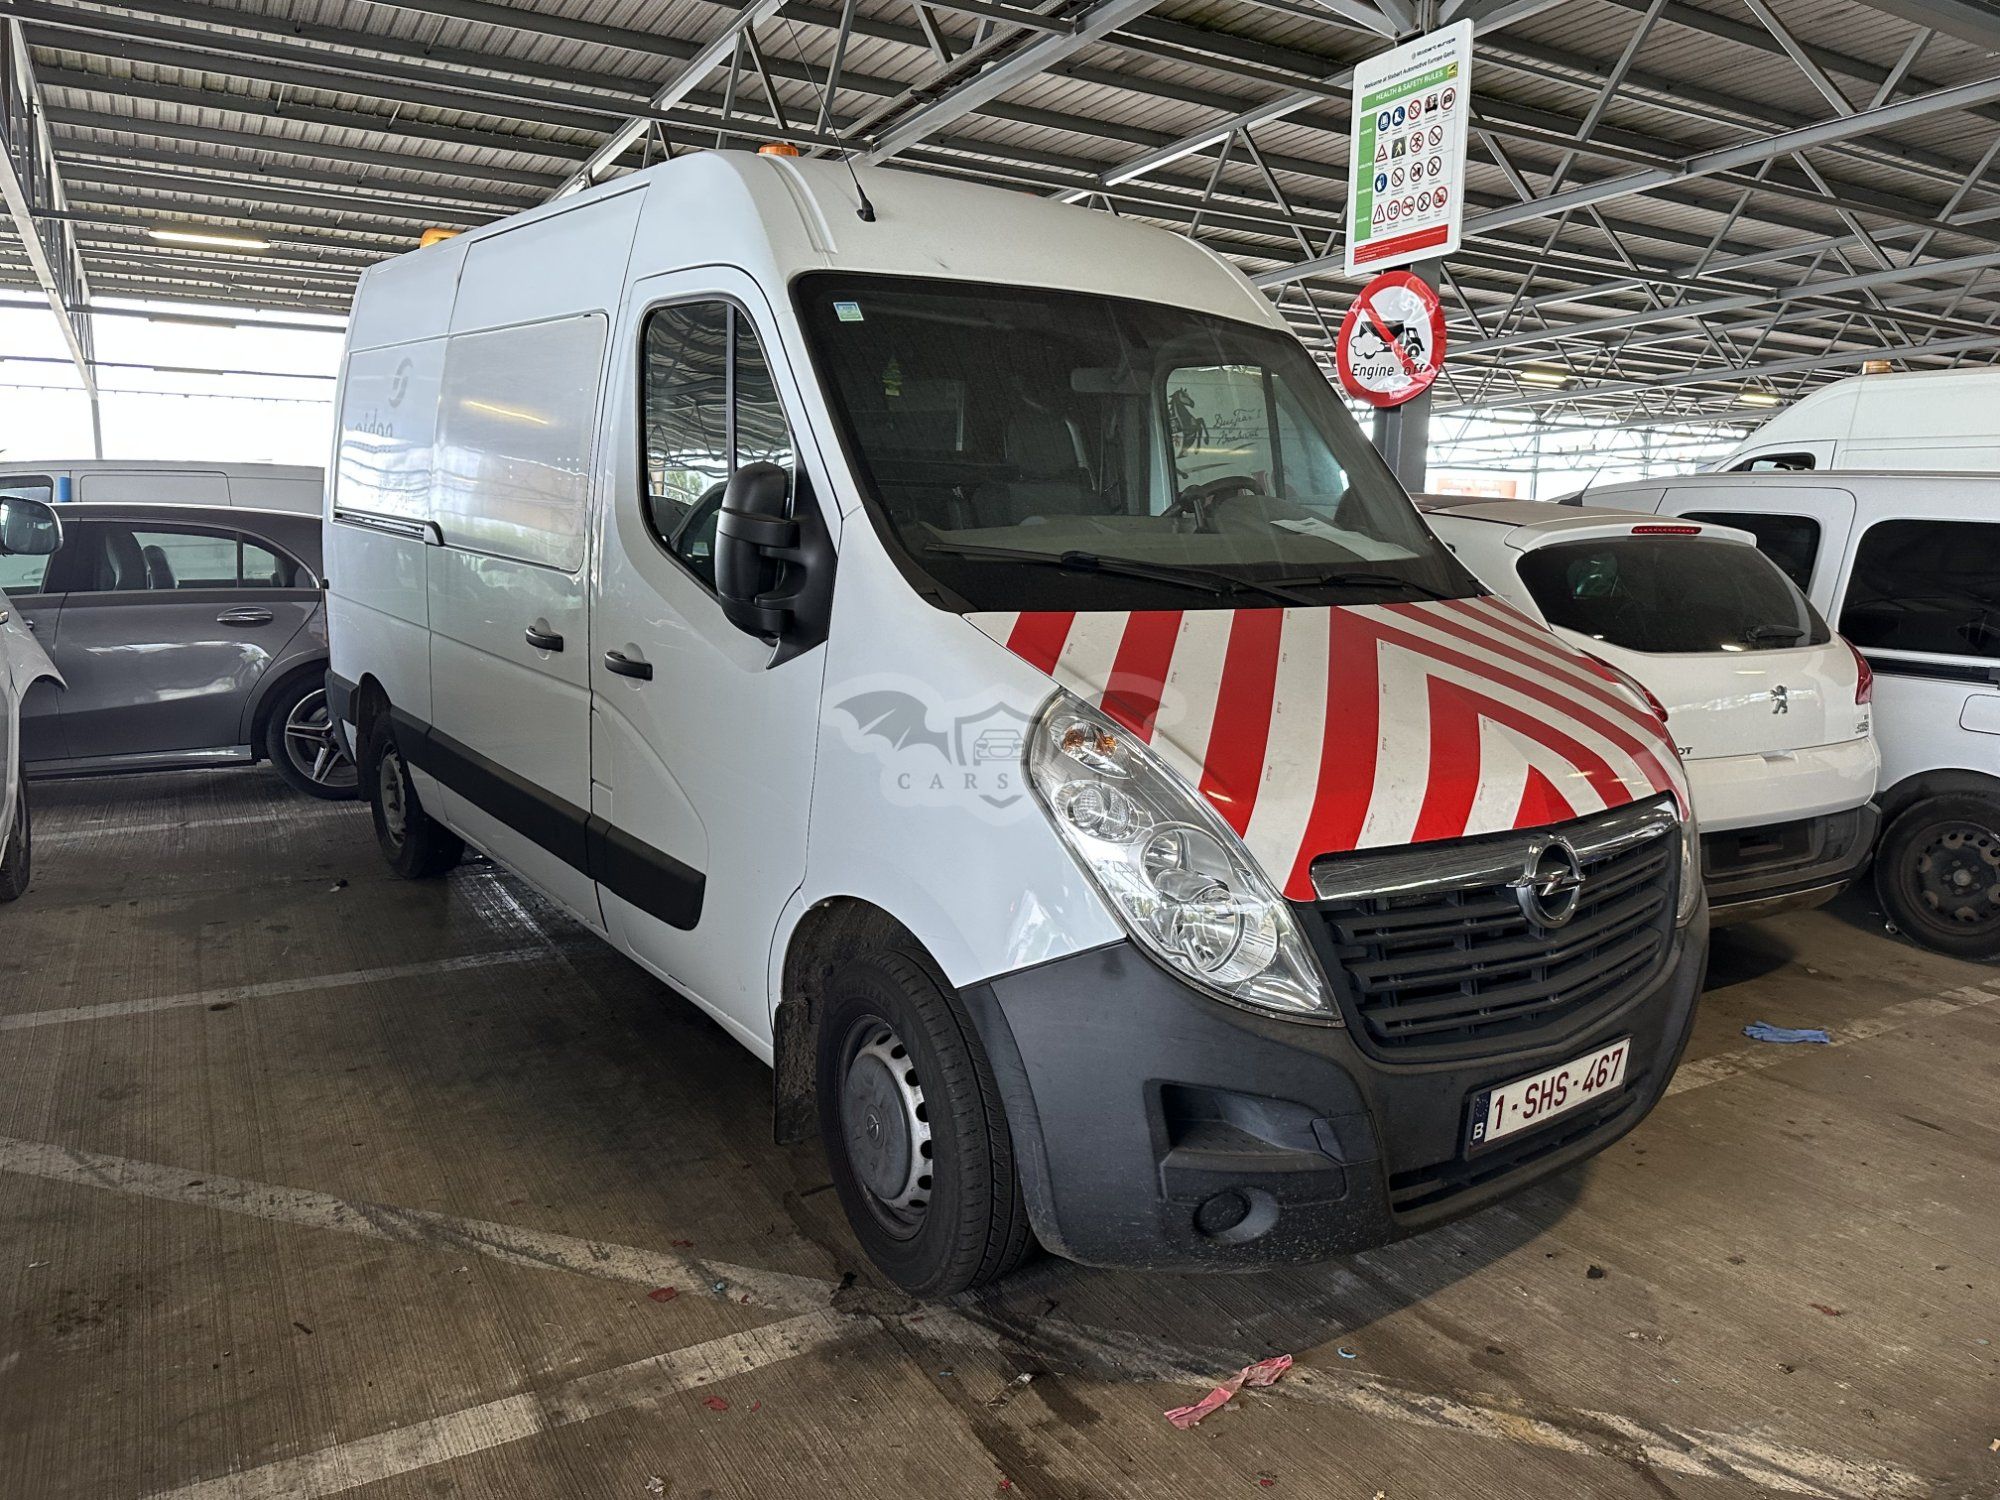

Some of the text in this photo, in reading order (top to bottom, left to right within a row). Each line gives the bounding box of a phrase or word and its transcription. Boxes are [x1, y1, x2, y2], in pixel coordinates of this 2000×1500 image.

[1376, 86, 1397, 101] HEALTH
[1402, 77, 1424, 91] SAFETY
[1424, 70, 1444, 83] RULES
[1389, 204, 1398, 215] 15
[1351, 363, 1426, 380] Engine off
[1678, 746, 1693, 755] OT
[1494, 1047, 1623, 1130] 1-SHS-467
[1473, 1122, 1484, 1140] B
